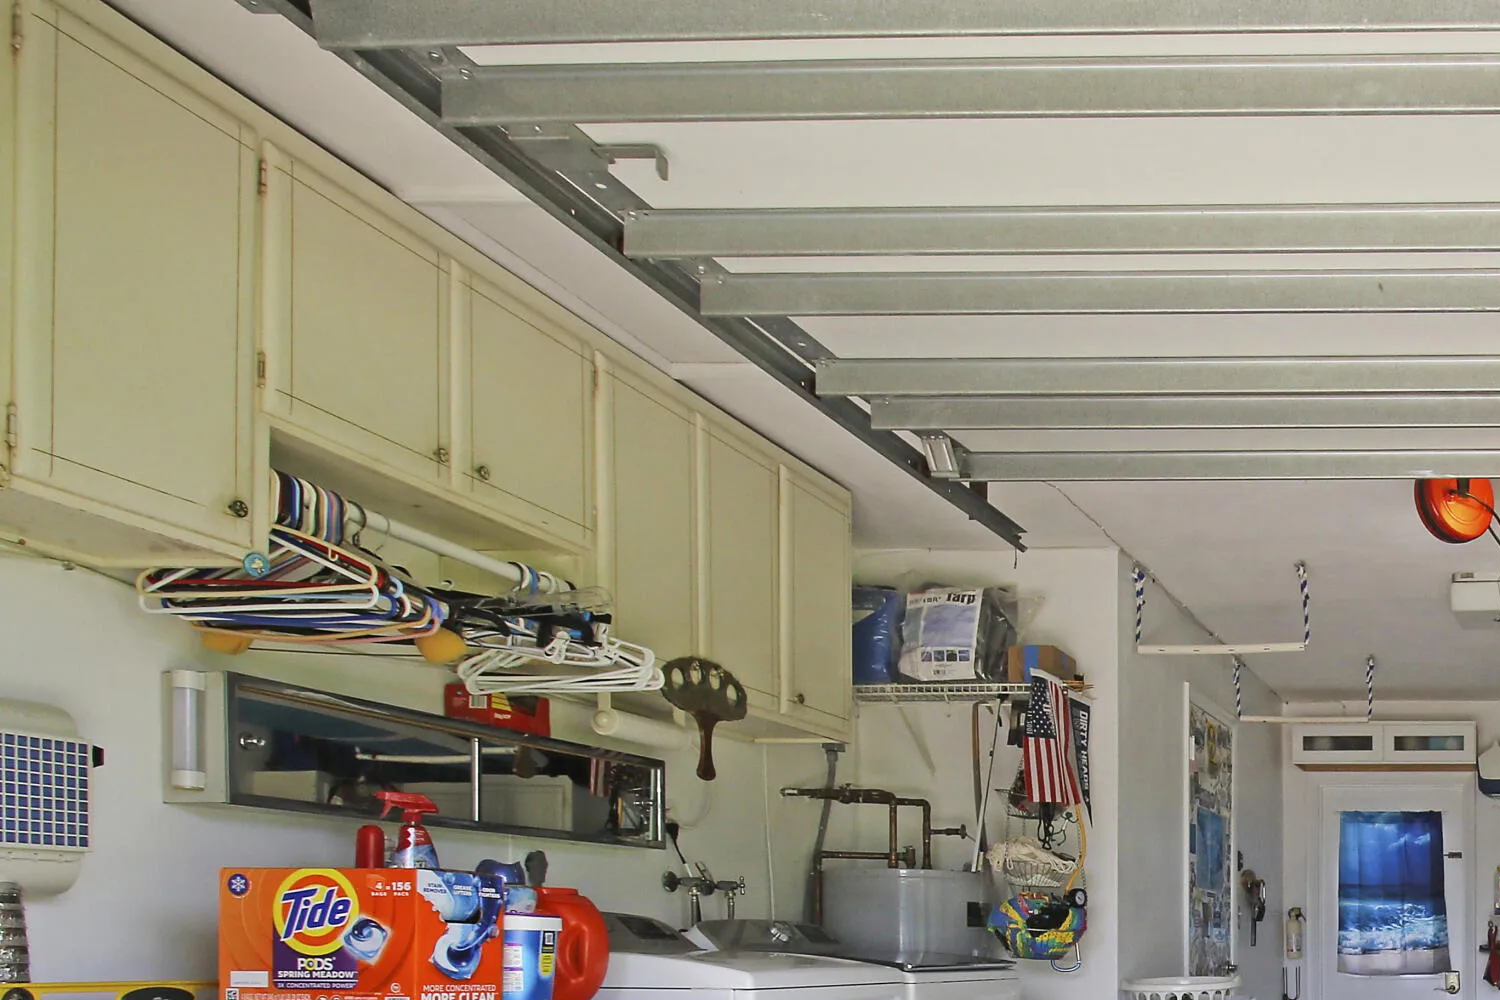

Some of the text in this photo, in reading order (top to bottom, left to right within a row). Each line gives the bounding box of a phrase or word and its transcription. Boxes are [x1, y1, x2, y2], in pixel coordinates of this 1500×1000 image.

[1079, 710, 1089, 790] DIRTY HEADS
[391, 882, 412, 891] 156
[280, 886, 353, 942] Tide
[297, 957, 334, 971] PODS
[278, 970, 354, 979] SPRING MEADOW
[423, 984, 497, 992] MORE CONCENTRATED
